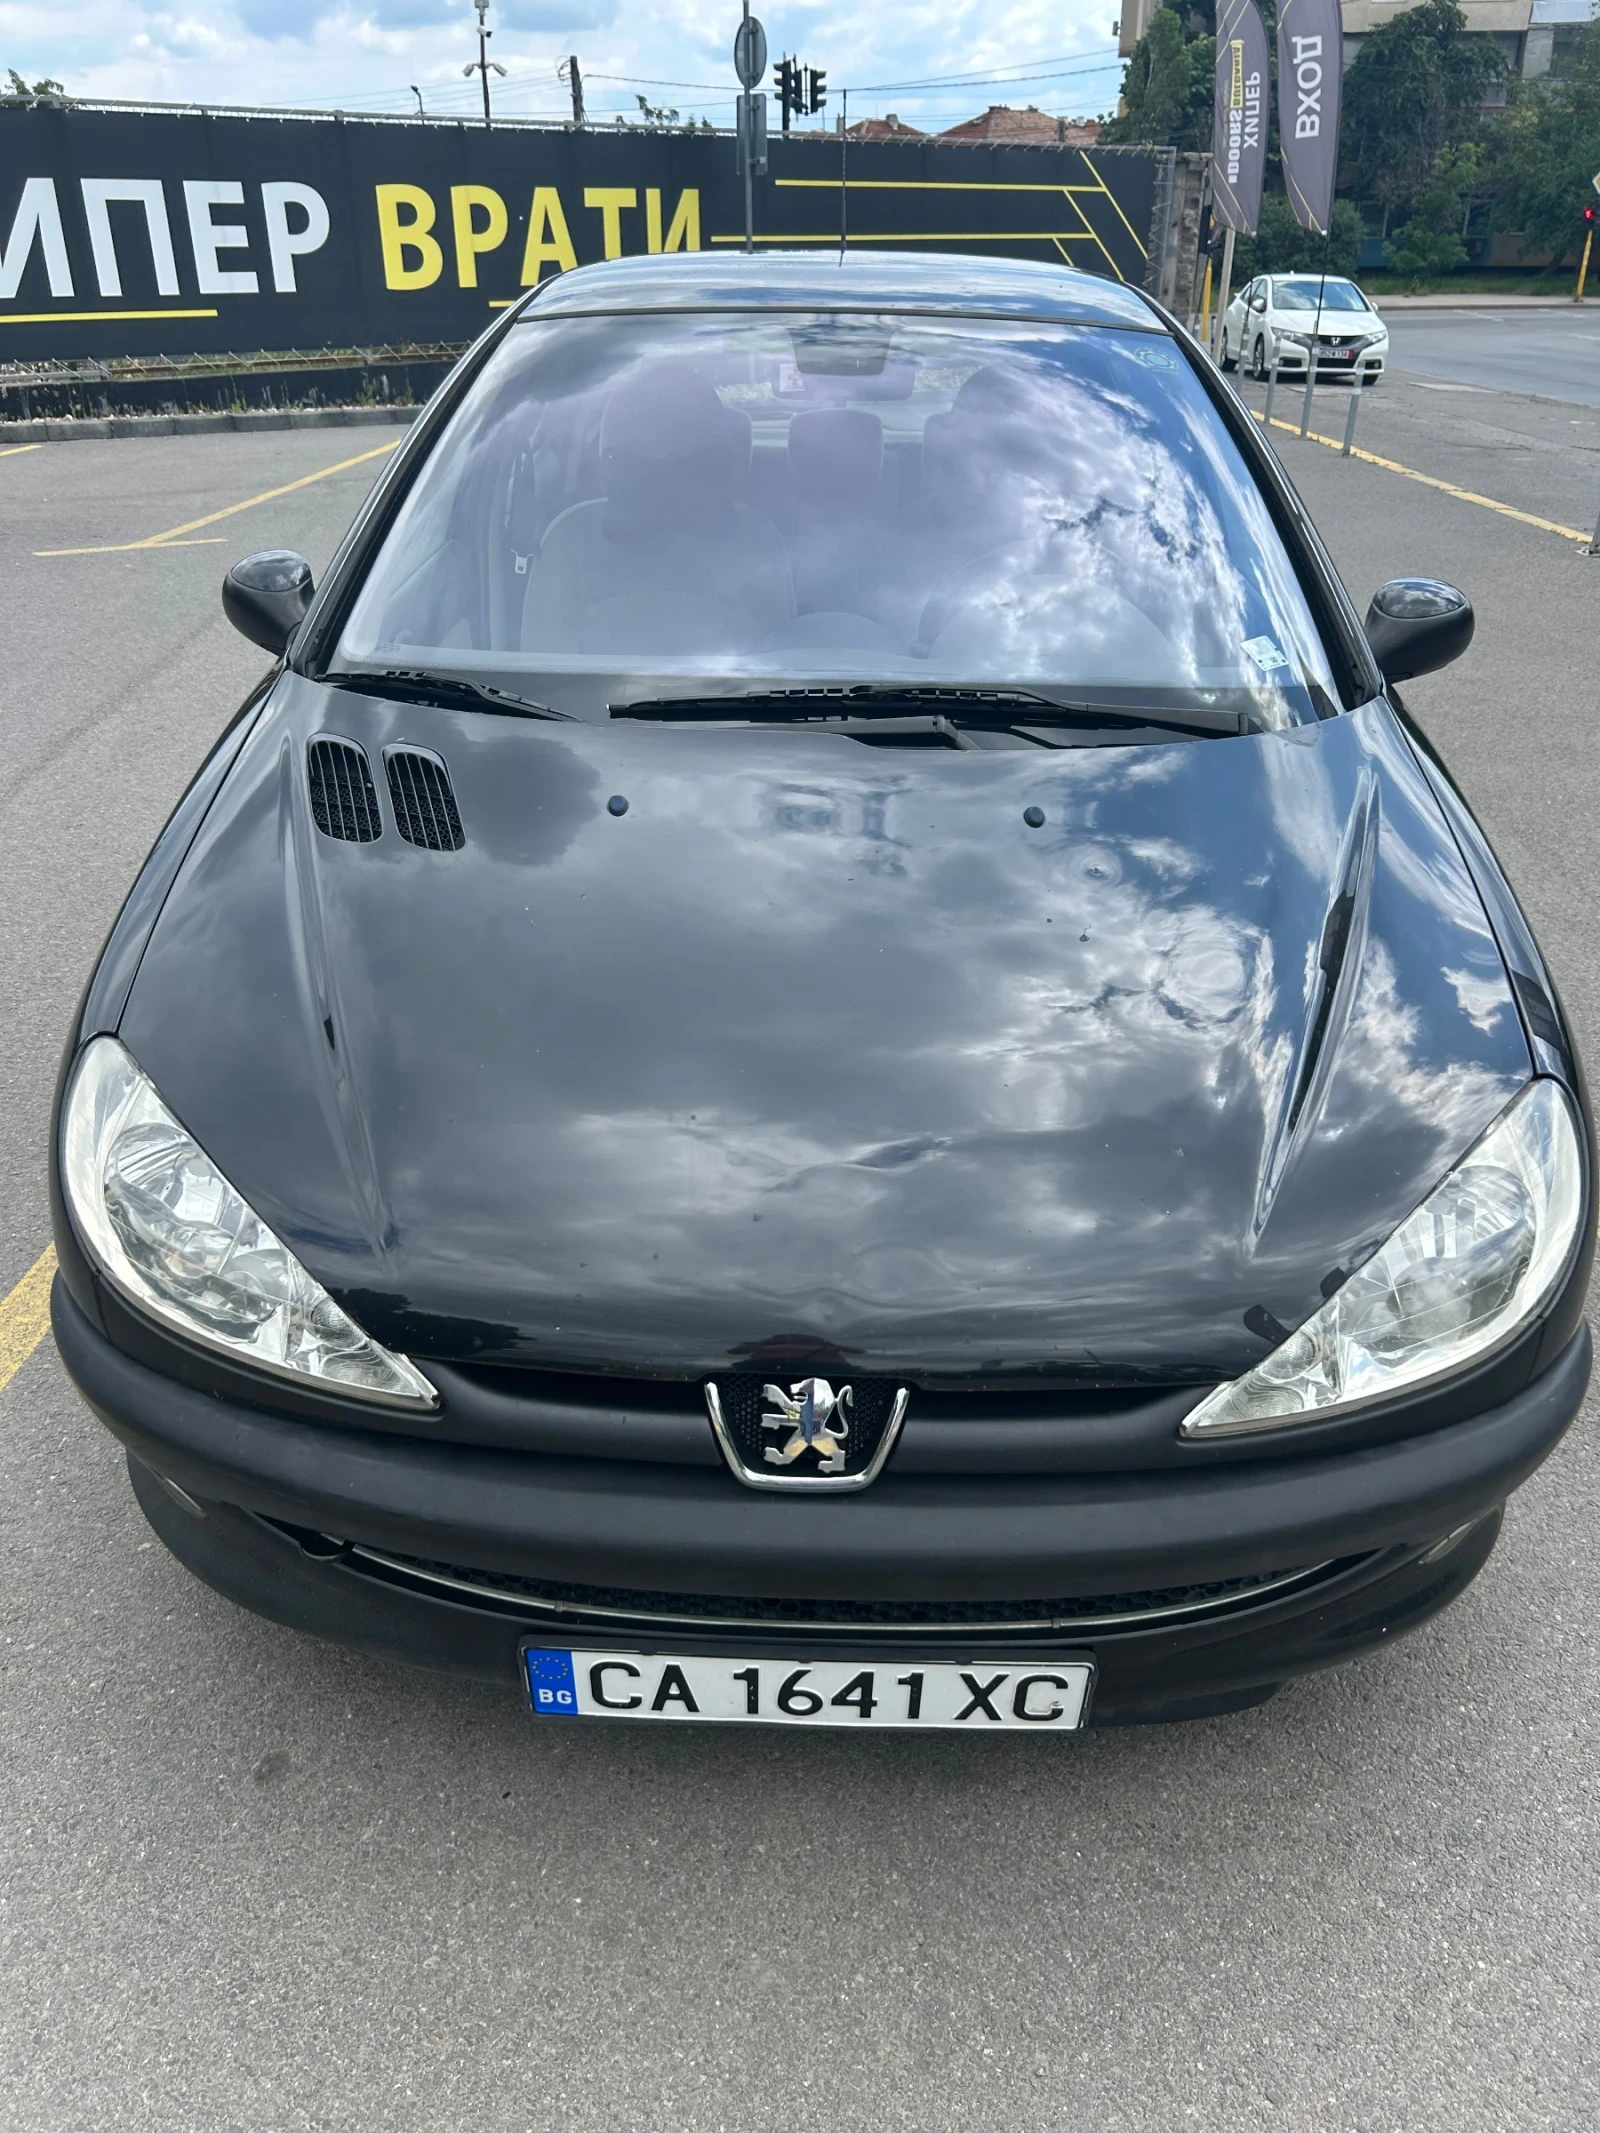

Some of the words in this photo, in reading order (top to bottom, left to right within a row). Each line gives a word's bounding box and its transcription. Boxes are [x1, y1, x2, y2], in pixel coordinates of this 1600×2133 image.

[375, 183, 700, 291] ВРАТИ
[539, 1688, 573, 1706] BG
[588, 1660, 700, 1713] CA
[732, 1667, 920, 1720] 1641
[953, 1672, 1069, 1721] XC
